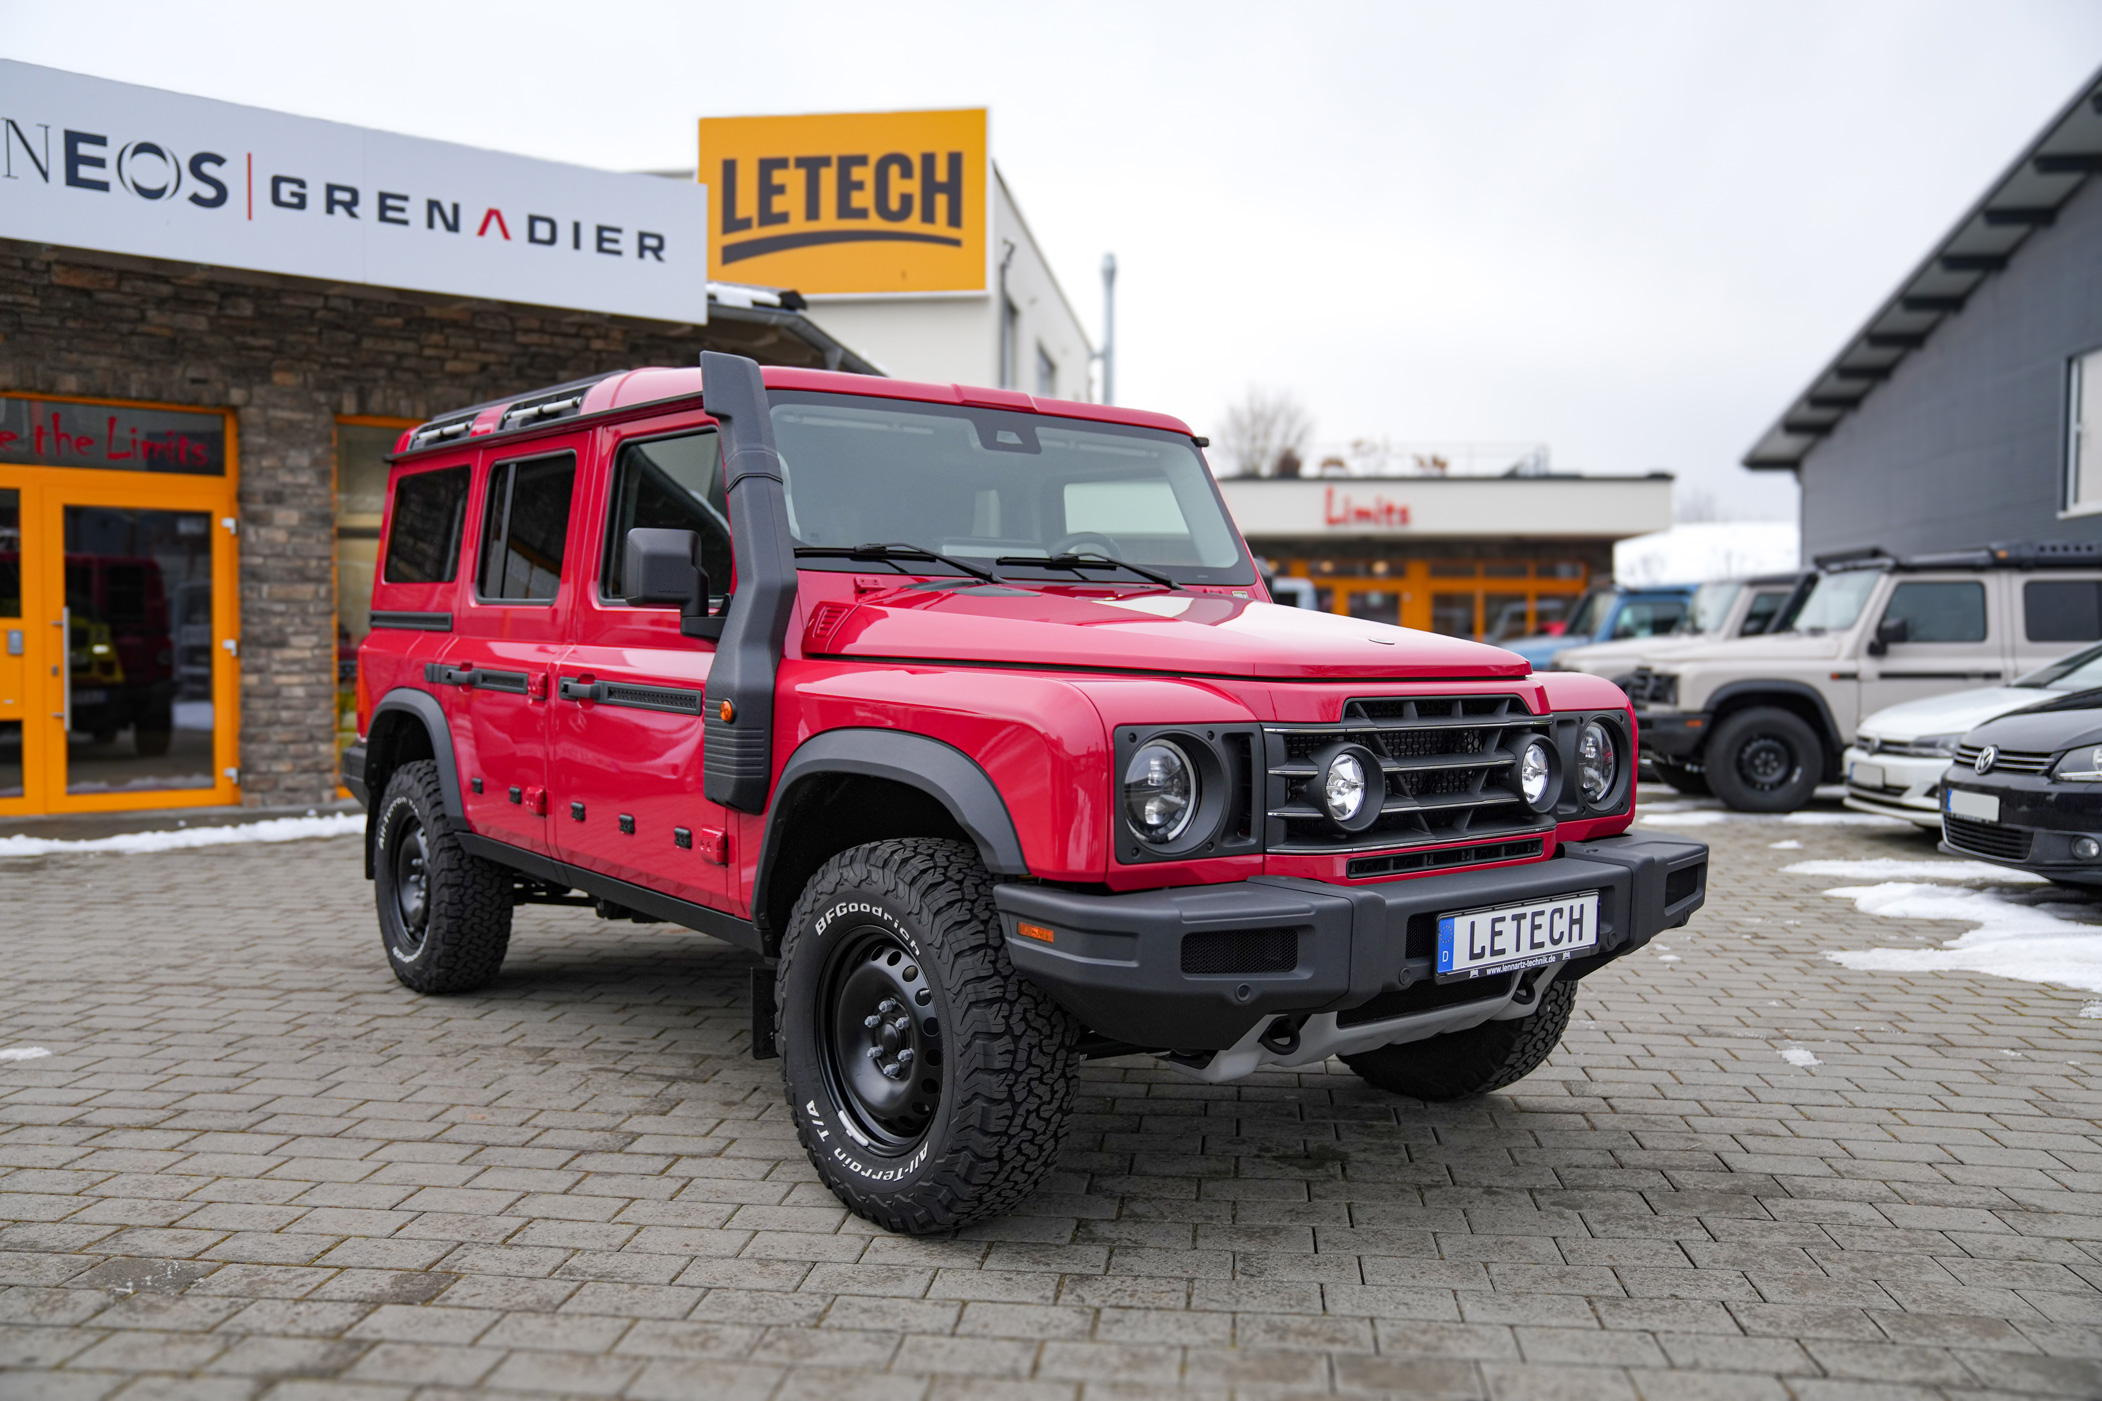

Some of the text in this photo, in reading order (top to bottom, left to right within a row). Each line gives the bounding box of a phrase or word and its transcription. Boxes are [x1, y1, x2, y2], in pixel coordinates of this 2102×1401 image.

[0, 117, 228, 208] NEOS
[270, 174, 667, 263] GRENADIER
[721, 151, 962, 236] LETECH
[33, 412, 94, 457] the
[107, 416, 208, 467] Limits
[1325, 486, 1411, 527] Limits
[815, 902, 920, 956] BFGoodrich
[1442, 951, 1449, 963] D
[1469, 904, 1584, 961] LETECH
[1486, 955, 1556, 975] www.lennartz-technik.de
[805, 1100, 929, 1182] All-Terrain T/A
